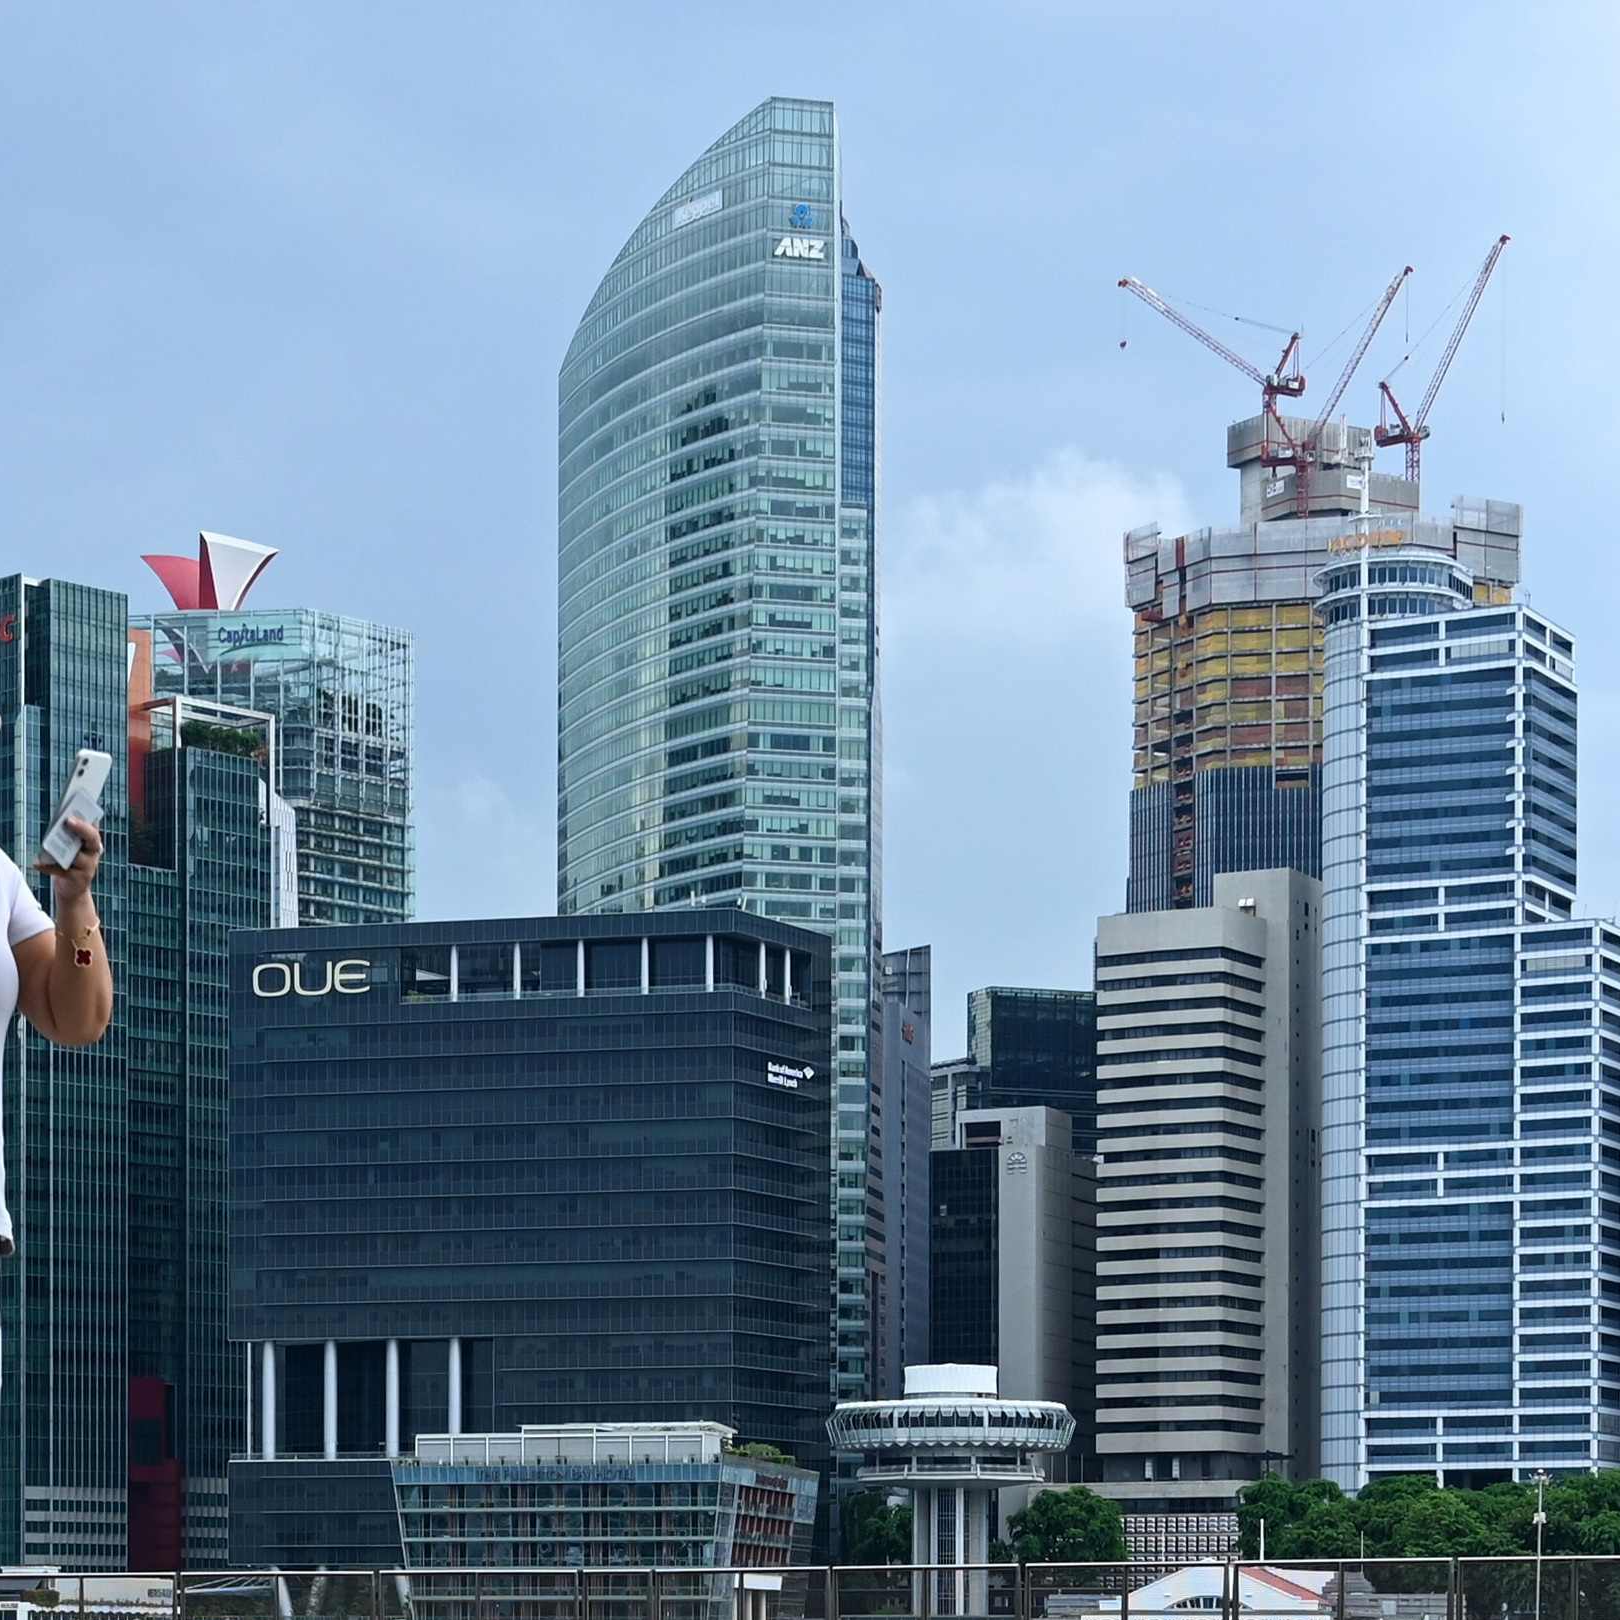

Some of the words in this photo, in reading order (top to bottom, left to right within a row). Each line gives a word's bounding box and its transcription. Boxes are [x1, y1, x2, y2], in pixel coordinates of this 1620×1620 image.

[774, 237, 825, 260] ANZ
[218, 622, 284, 648] CapitaLand
[252, 959, 371, 998] OUE
